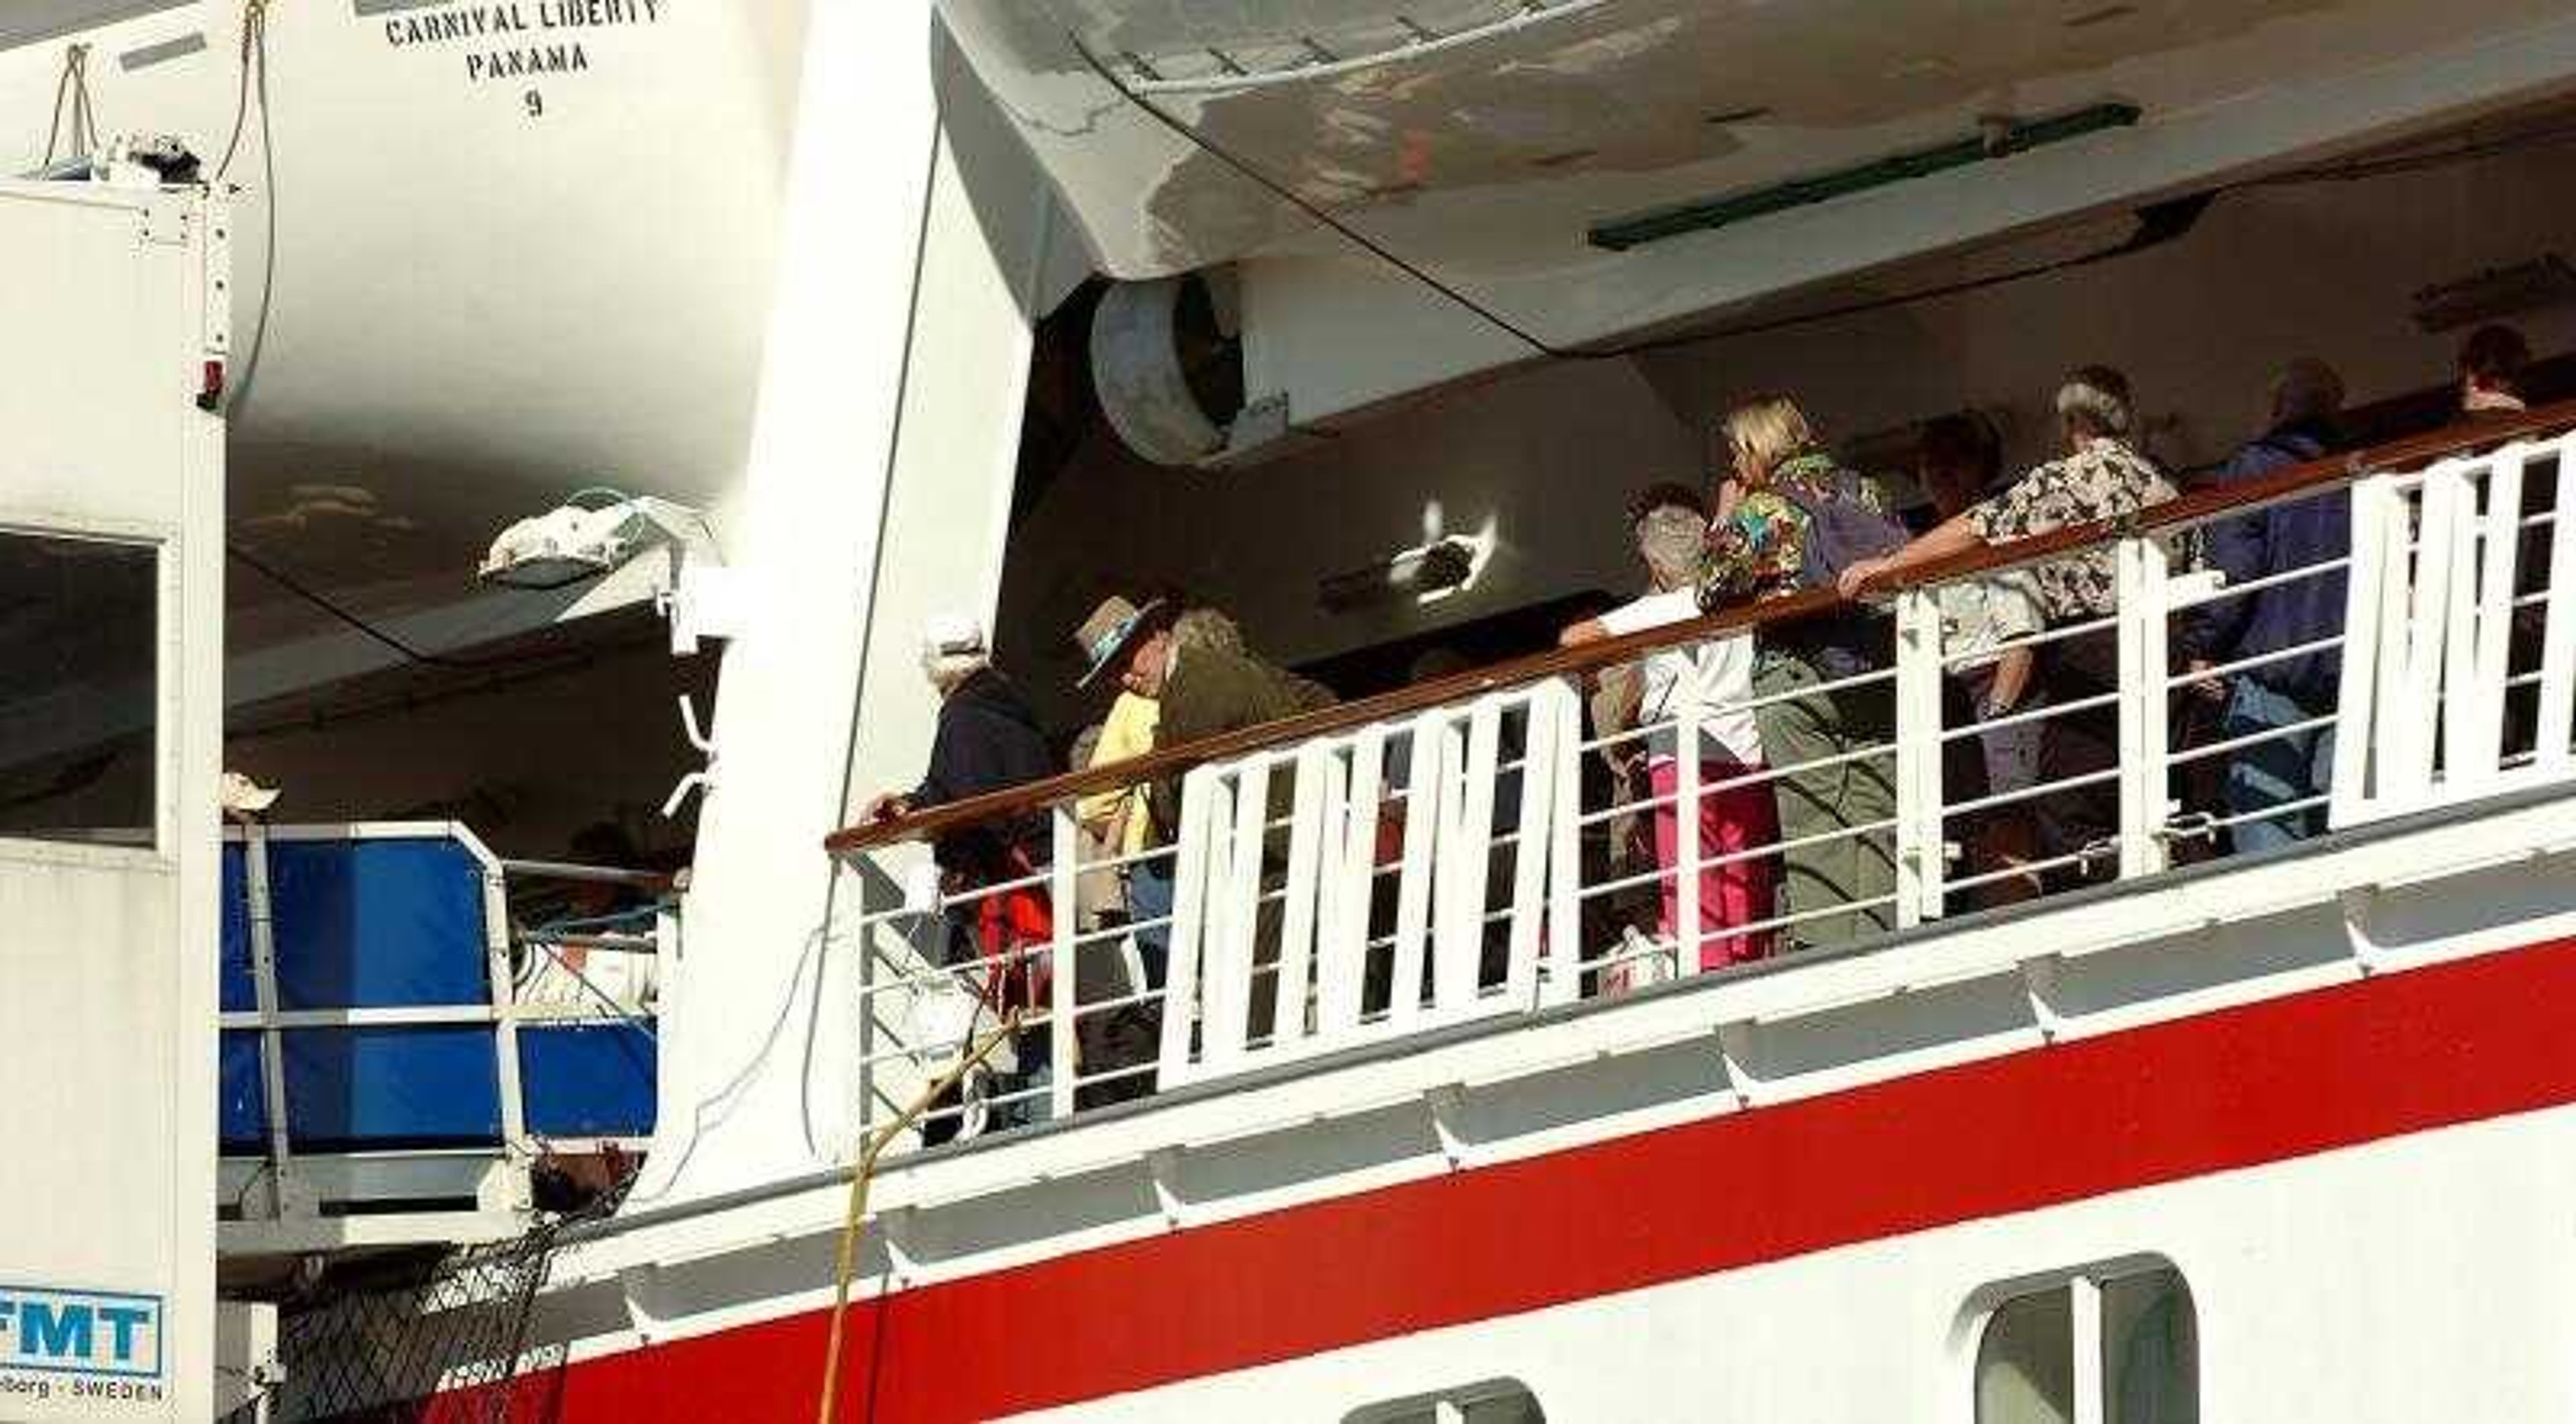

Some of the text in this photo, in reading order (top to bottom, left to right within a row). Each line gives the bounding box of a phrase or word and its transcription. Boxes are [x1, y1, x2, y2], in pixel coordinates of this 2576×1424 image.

[386, 0, 657, 46] CARNIVAL LIBERTY
[466, 44, 588, 81] PANAMA
[525, 89, 542, 117] 9
[72, 1378, 162, 1401] SWEDEN
